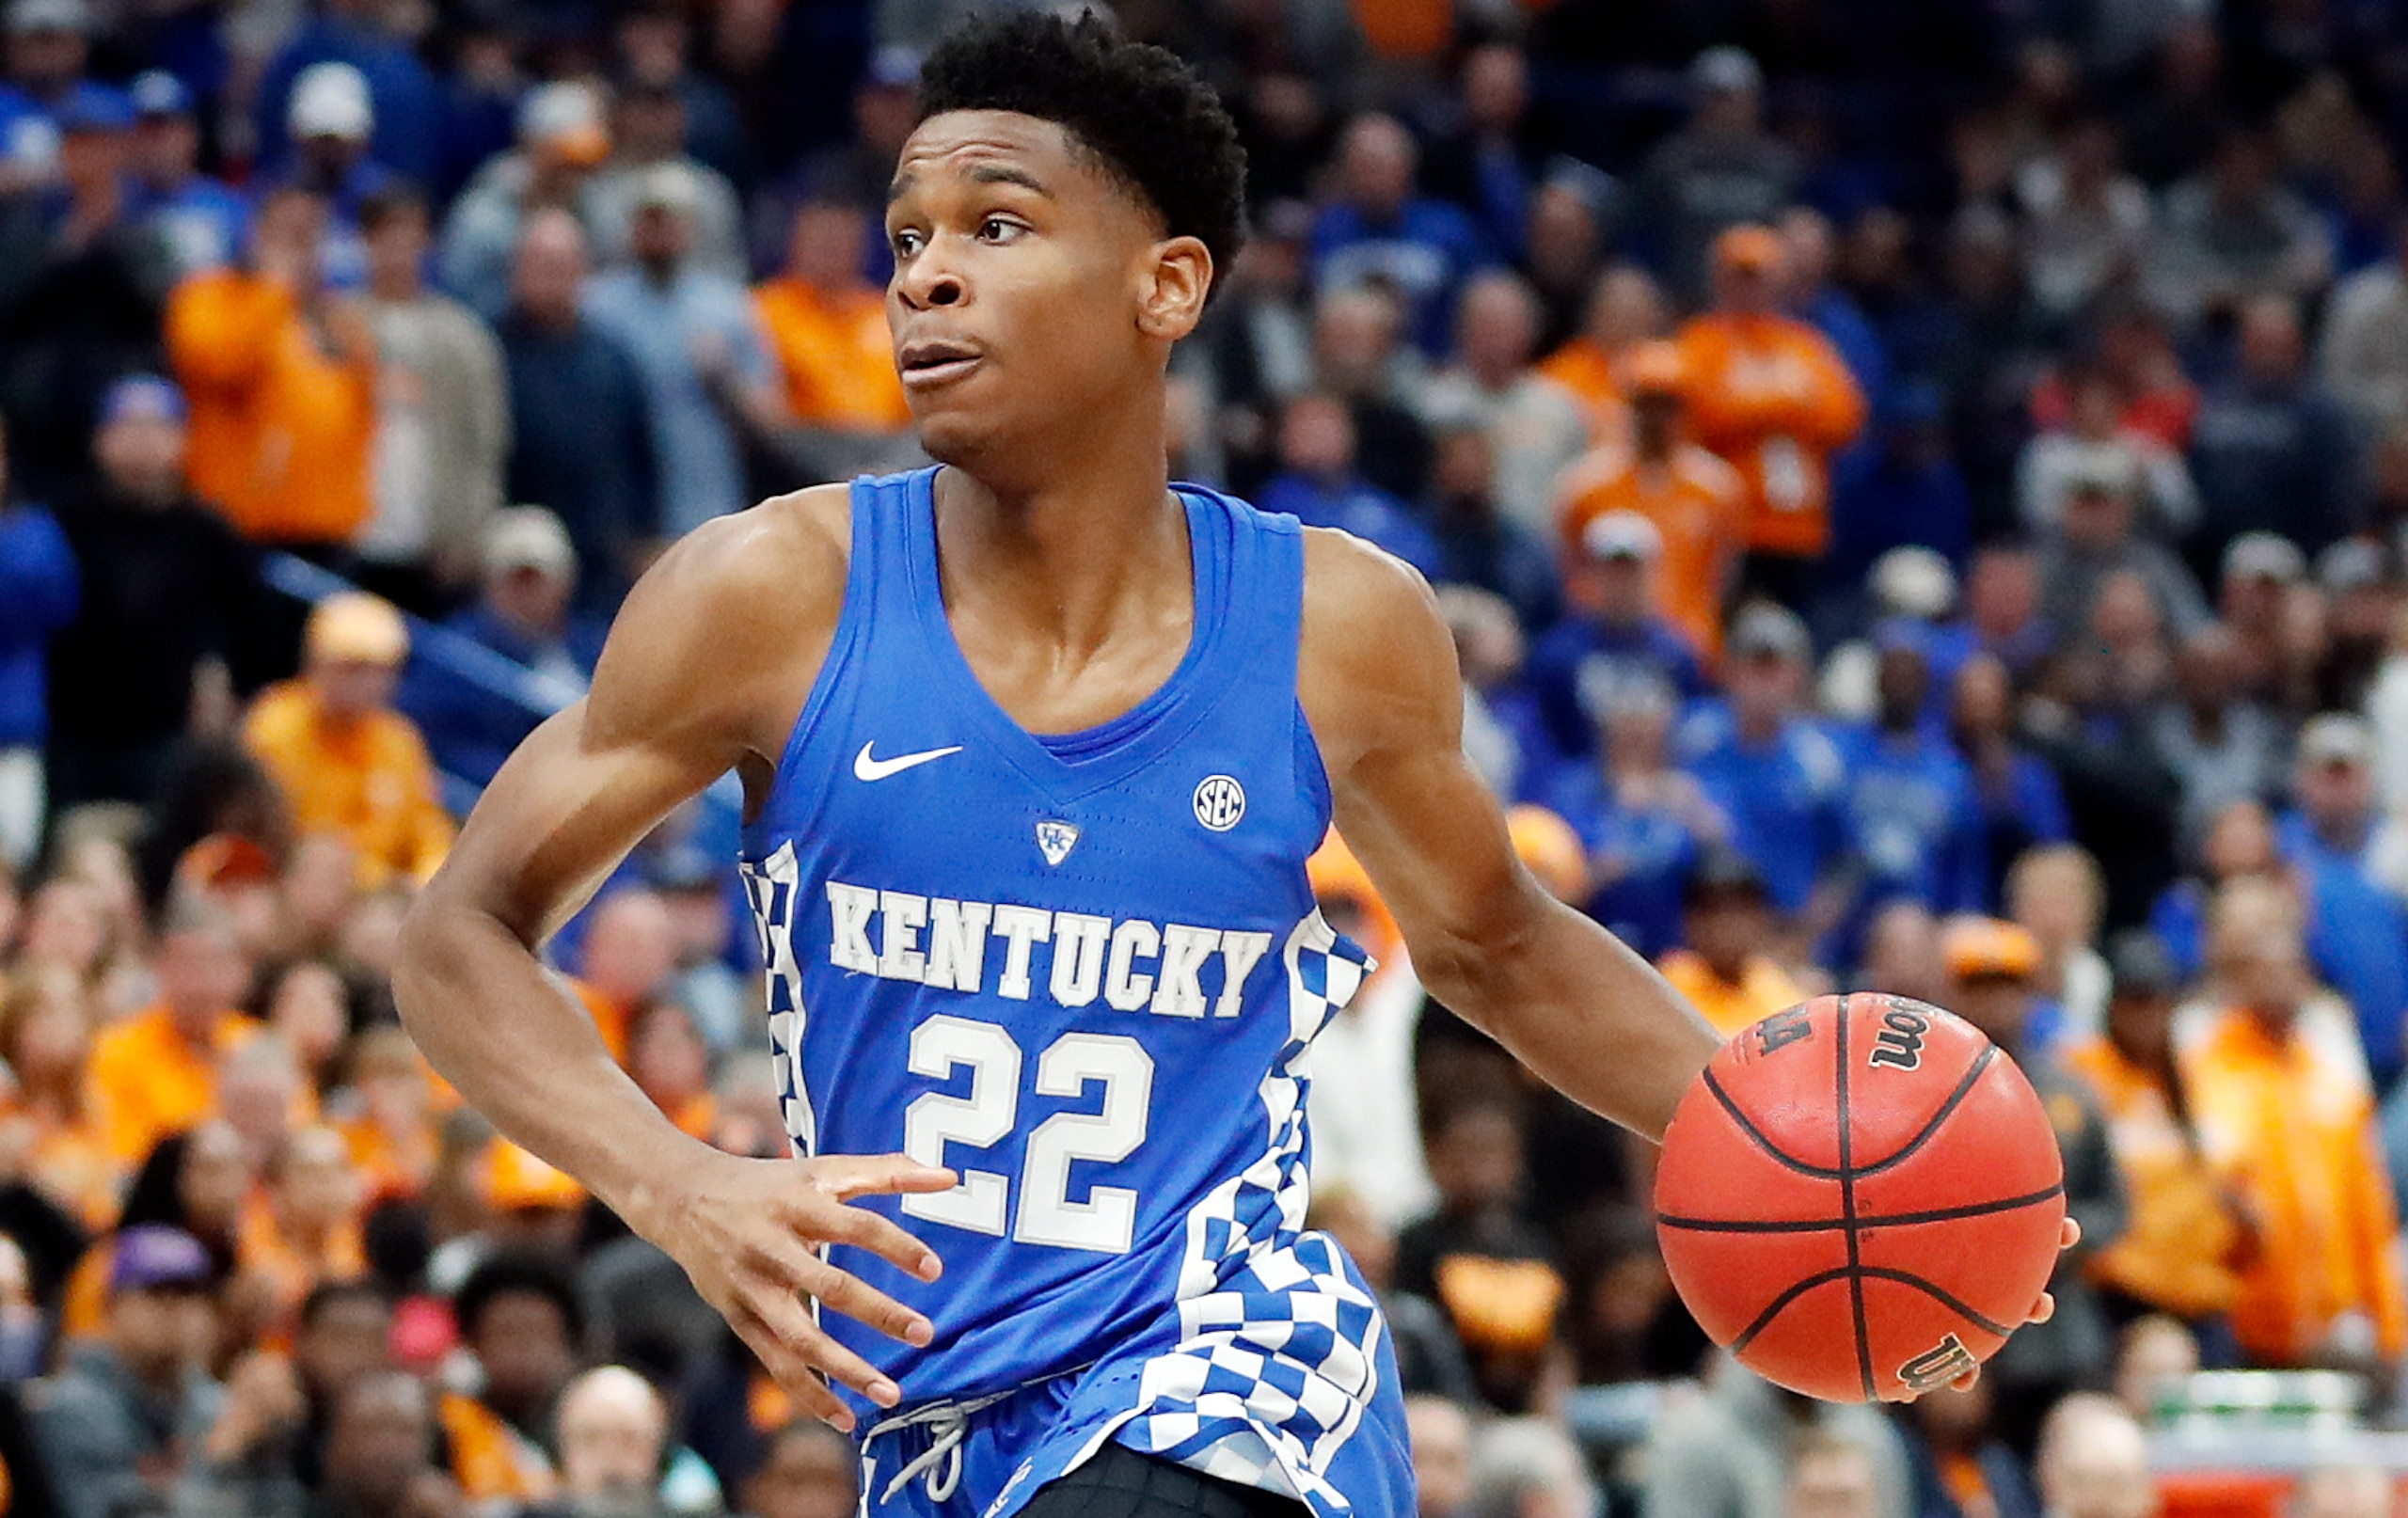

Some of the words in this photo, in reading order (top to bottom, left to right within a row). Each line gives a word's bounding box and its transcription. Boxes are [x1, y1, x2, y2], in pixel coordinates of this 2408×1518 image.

[1196, 779, 1243, 827] SEC
[826, 880, 1273, 1019] KENTUCKY
[901, 1013, 1156, 1254] 22
